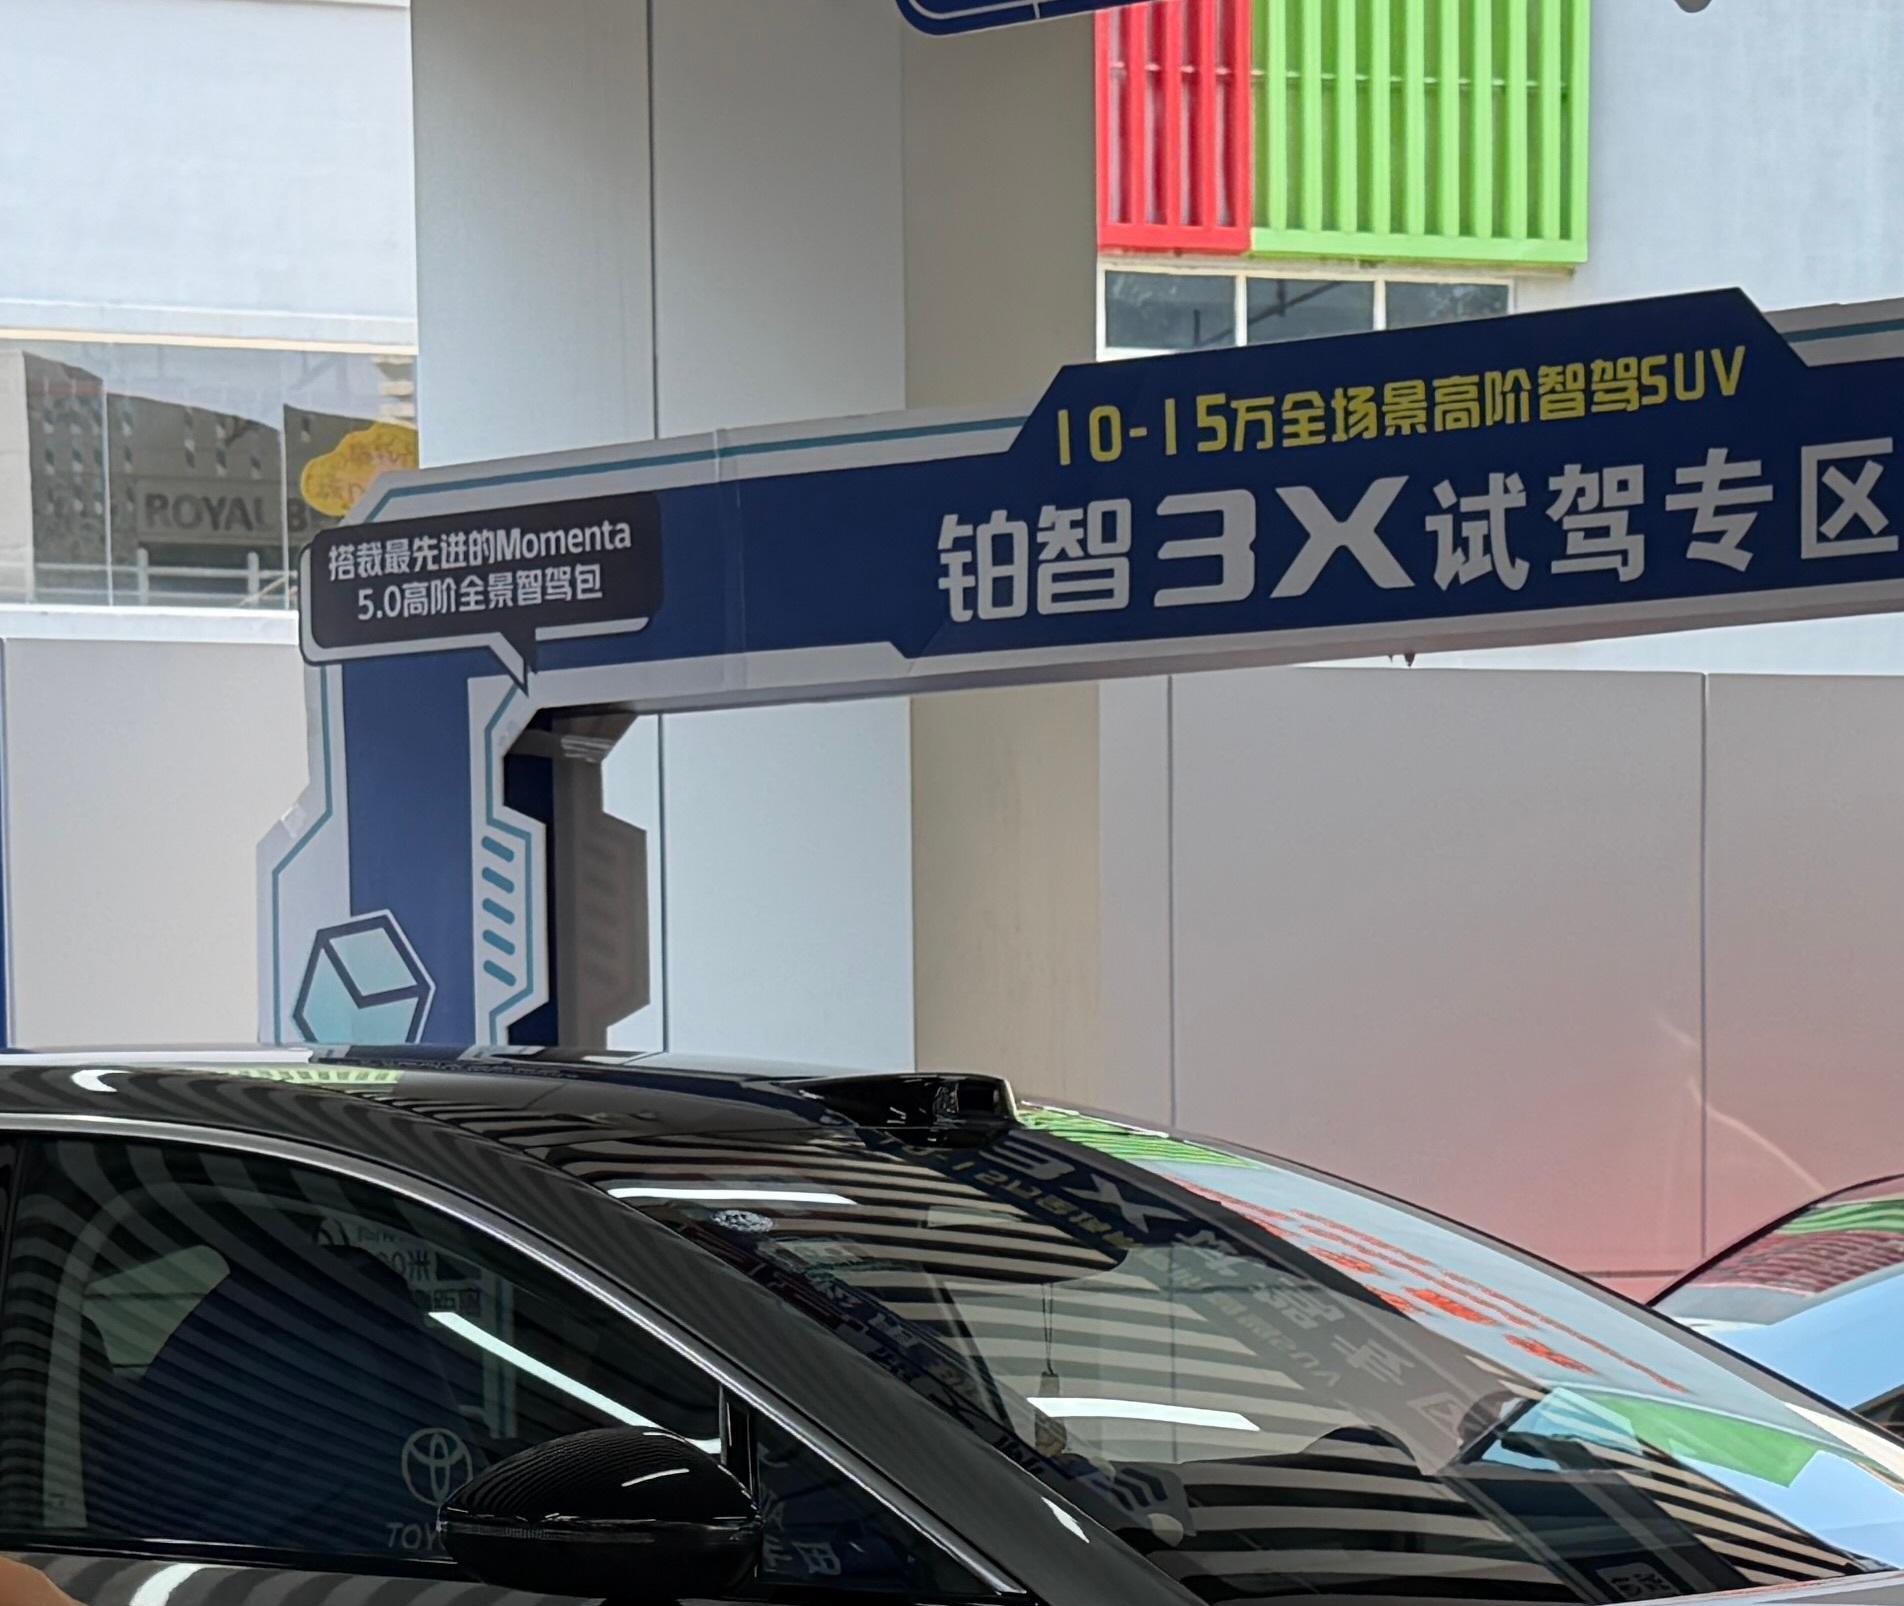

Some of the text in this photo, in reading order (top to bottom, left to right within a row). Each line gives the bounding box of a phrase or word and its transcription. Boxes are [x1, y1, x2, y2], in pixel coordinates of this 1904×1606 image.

[1057, 345, 1746, 466] 10-15万全场景高阶智驾SUV
[937, 437, 1899, 623] 铂智3X试驾专区
[357, 563, 603, 621] 5.0高阶全景智驾包
